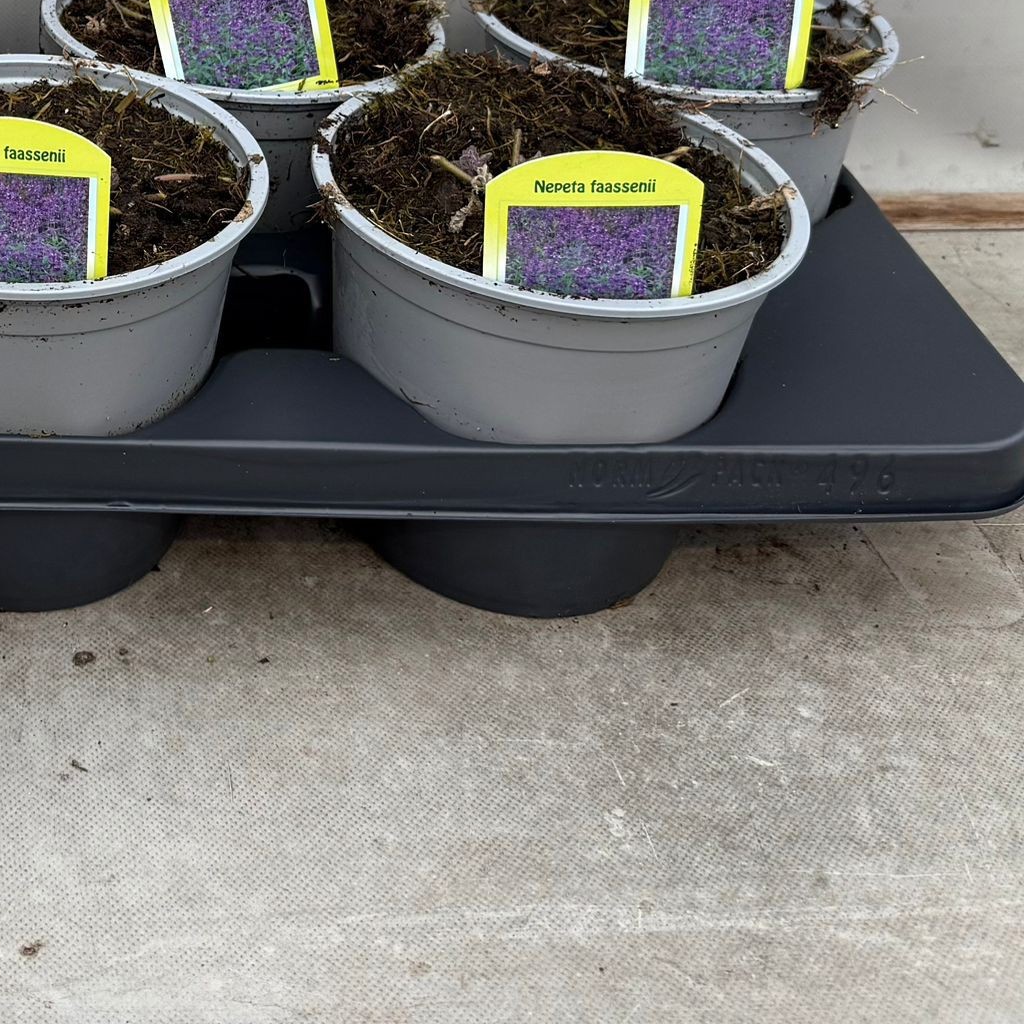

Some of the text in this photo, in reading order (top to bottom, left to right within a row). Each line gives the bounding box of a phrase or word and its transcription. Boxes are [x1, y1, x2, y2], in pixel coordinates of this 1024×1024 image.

[3, 145, 67, 163] faassenii
[534, 178, 657, 194] Nepeta faassenii
